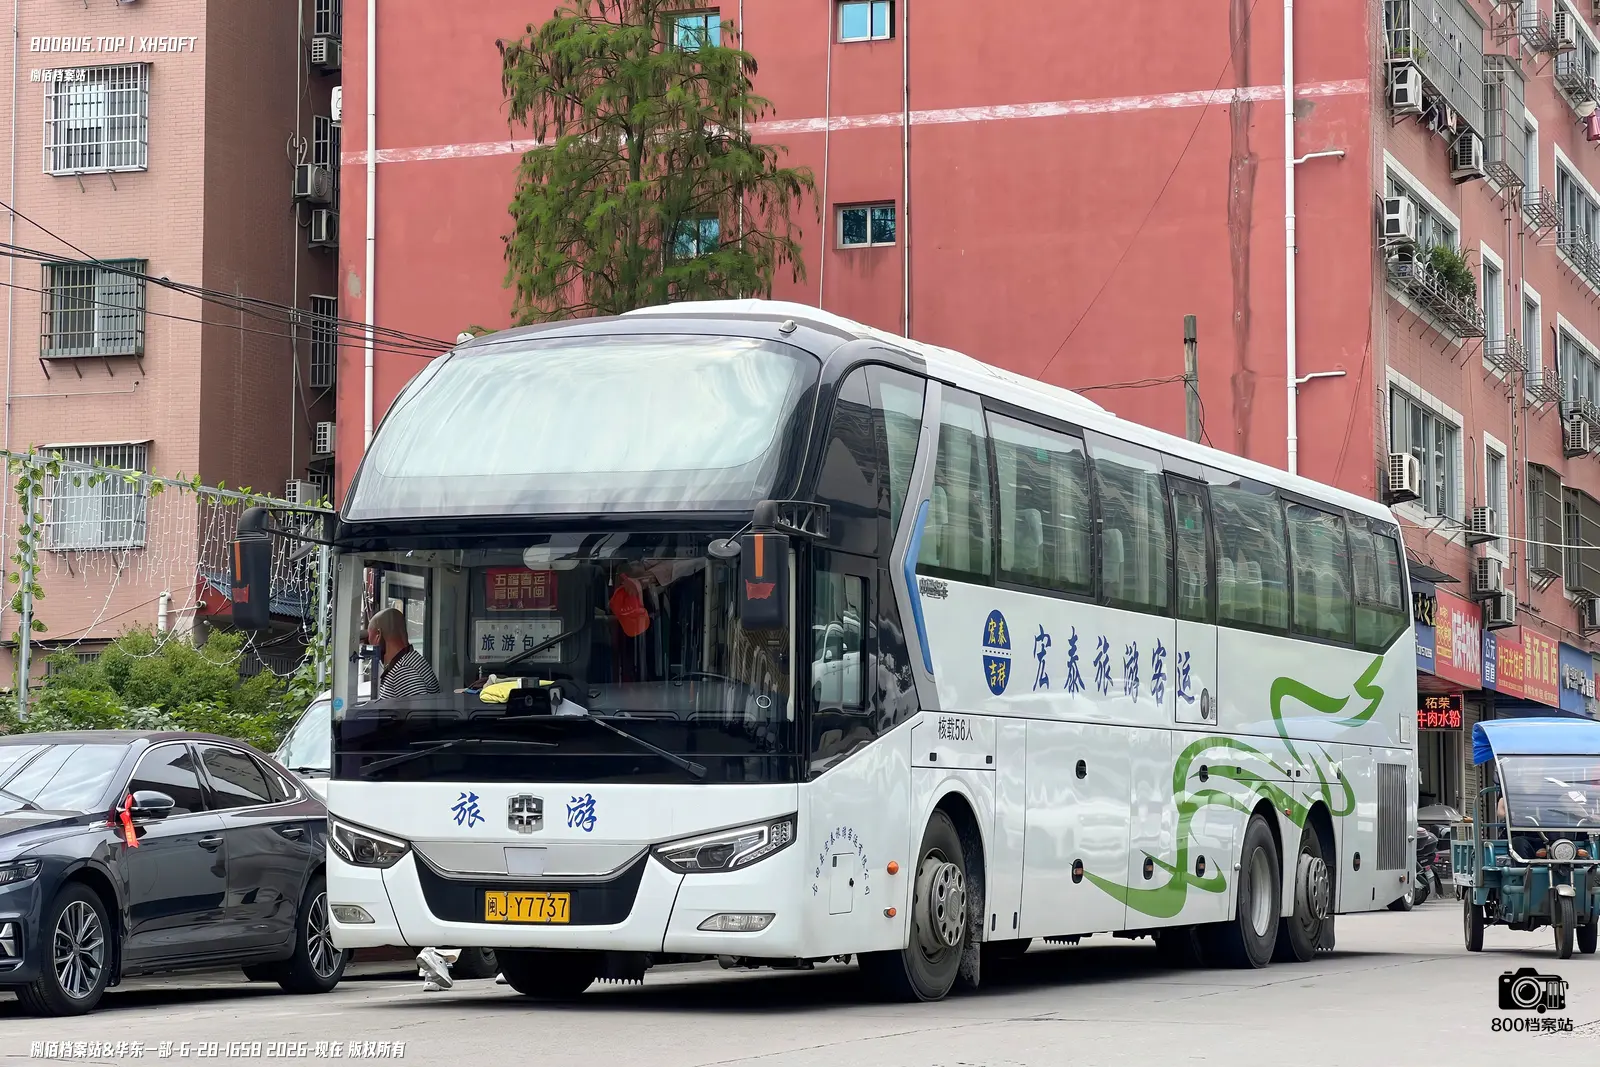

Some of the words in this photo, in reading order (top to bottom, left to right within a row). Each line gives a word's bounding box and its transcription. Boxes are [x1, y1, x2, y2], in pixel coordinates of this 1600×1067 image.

[988, 617, 1007, 647] 宏泰
[988, 659, 1006, 688] 吉祥
[1032, 623, 1196, 708] 宏泰旅游客运
[1425, 696, 1450, 709] 柘荣
[938, 715, 974, 741] 核载56人
[1416, 709, 1461, 728] 牛肉水粉
